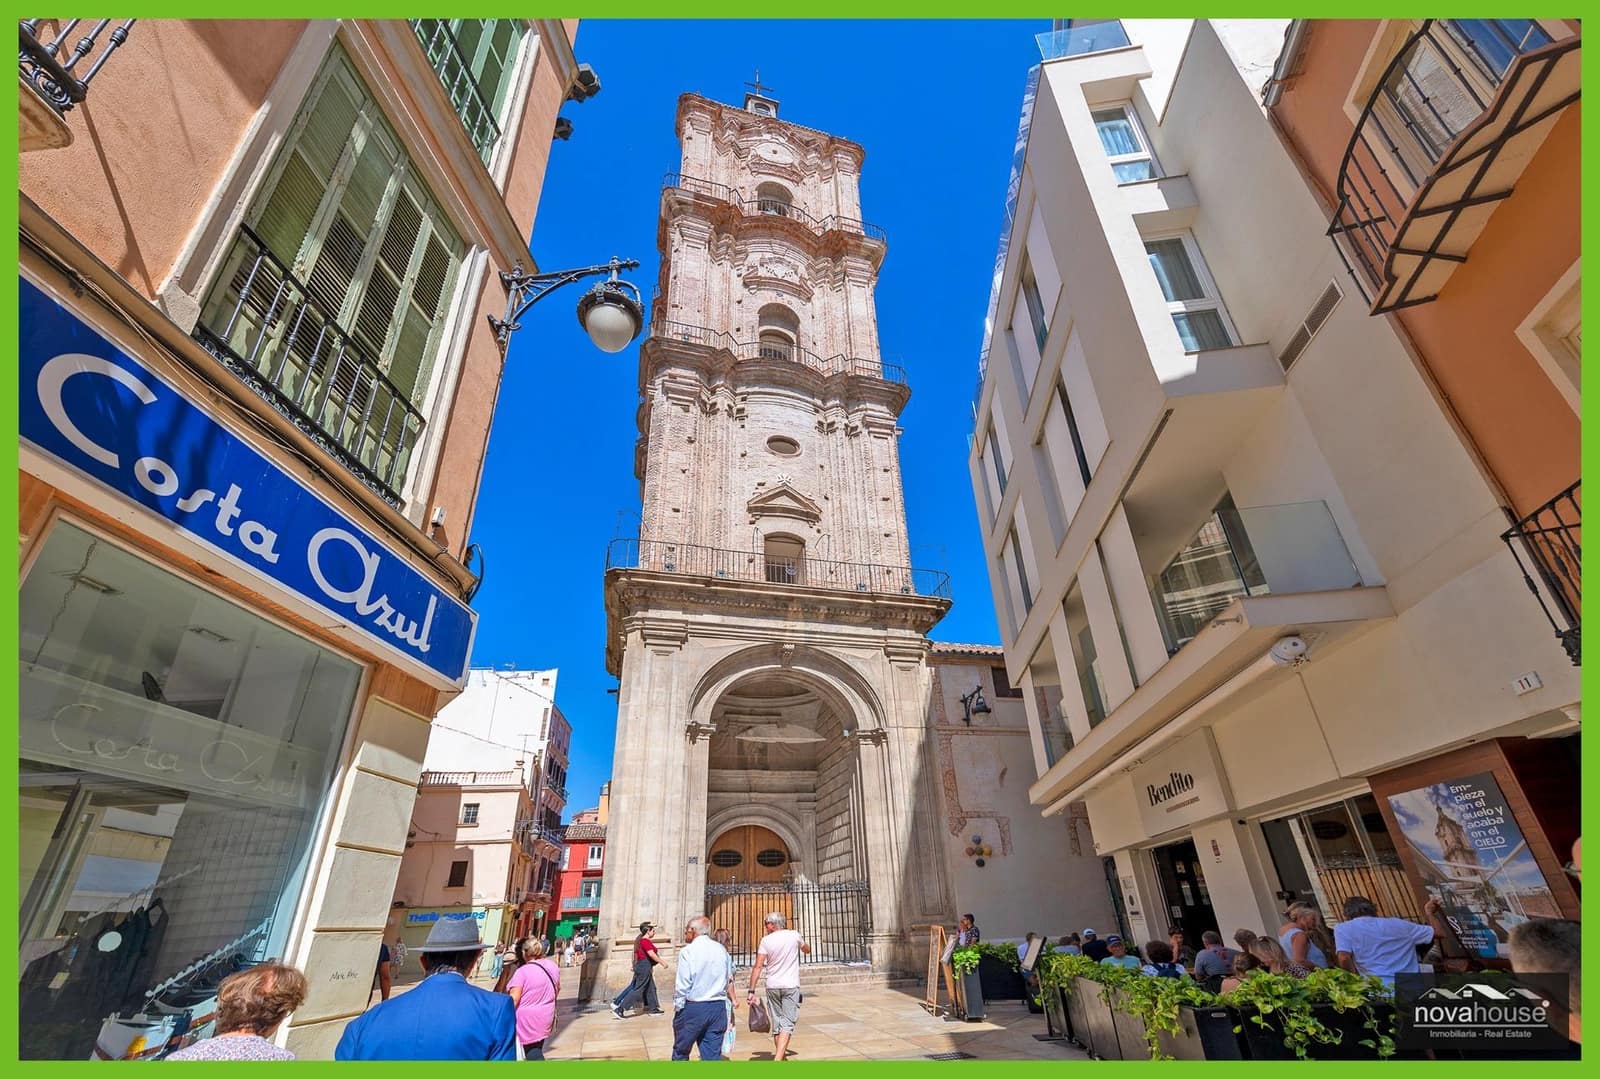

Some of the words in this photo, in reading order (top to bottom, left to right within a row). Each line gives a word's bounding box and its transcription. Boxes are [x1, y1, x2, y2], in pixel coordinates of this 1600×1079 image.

[36, 353, 280, 565] Costa
[307, 527, 438, 653] Azul
[1518, 677, 1532, 690] 11
[52, 703, 185, 773] Costa
[1147, 772, 1194, 807] Bendito
[1454, 790, 1486, 804] pieza
[1459, 803, 1474, 812] en
[1475, 798, 1486, 808] el
[1462, 807, 1494, 820] suelo
[1495, 805, 1504, 816] y
[1467, 816, 1504, 829] acaba
[1471, 829, 1487, 838] en
[1488, 826, 1500, 836] el
[1475, 836, 1506, 847] CIELO
